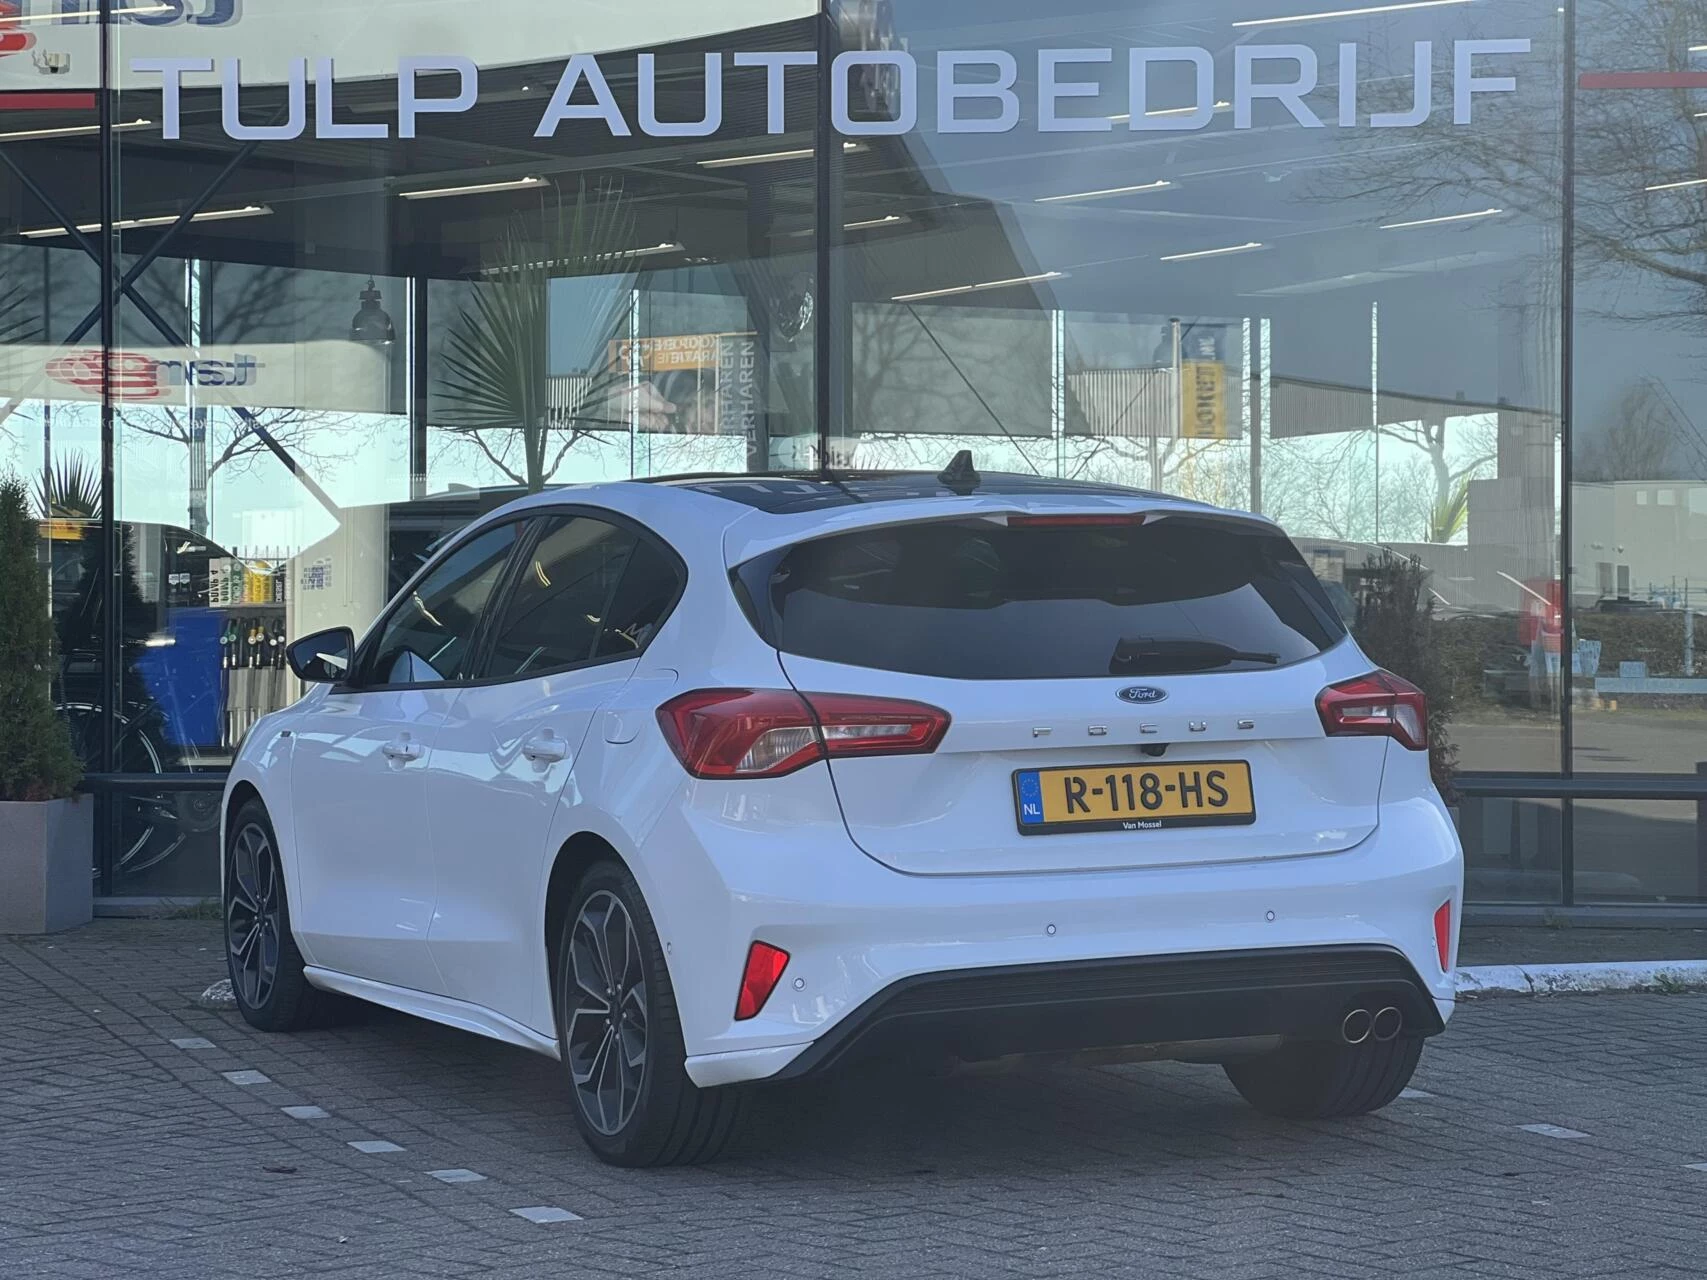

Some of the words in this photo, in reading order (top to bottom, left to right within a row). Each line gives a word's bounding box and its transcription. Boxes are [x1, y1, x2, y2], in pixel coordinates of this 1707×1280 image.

[130, 56, 478, 141] TULP
[533, 39, 1532, 138] AUTOBEDRIJF
[1128, 687, 1156, 699] Ford
[1032, 719, 1255, 738] FOCUS
[1024, 803, 1041, 816] NL
[1063, 769, 1229, 814] R-118-HS
[1122, 821, 1137, 830] Van
[1137, 819, 1162, 829] Mossel
